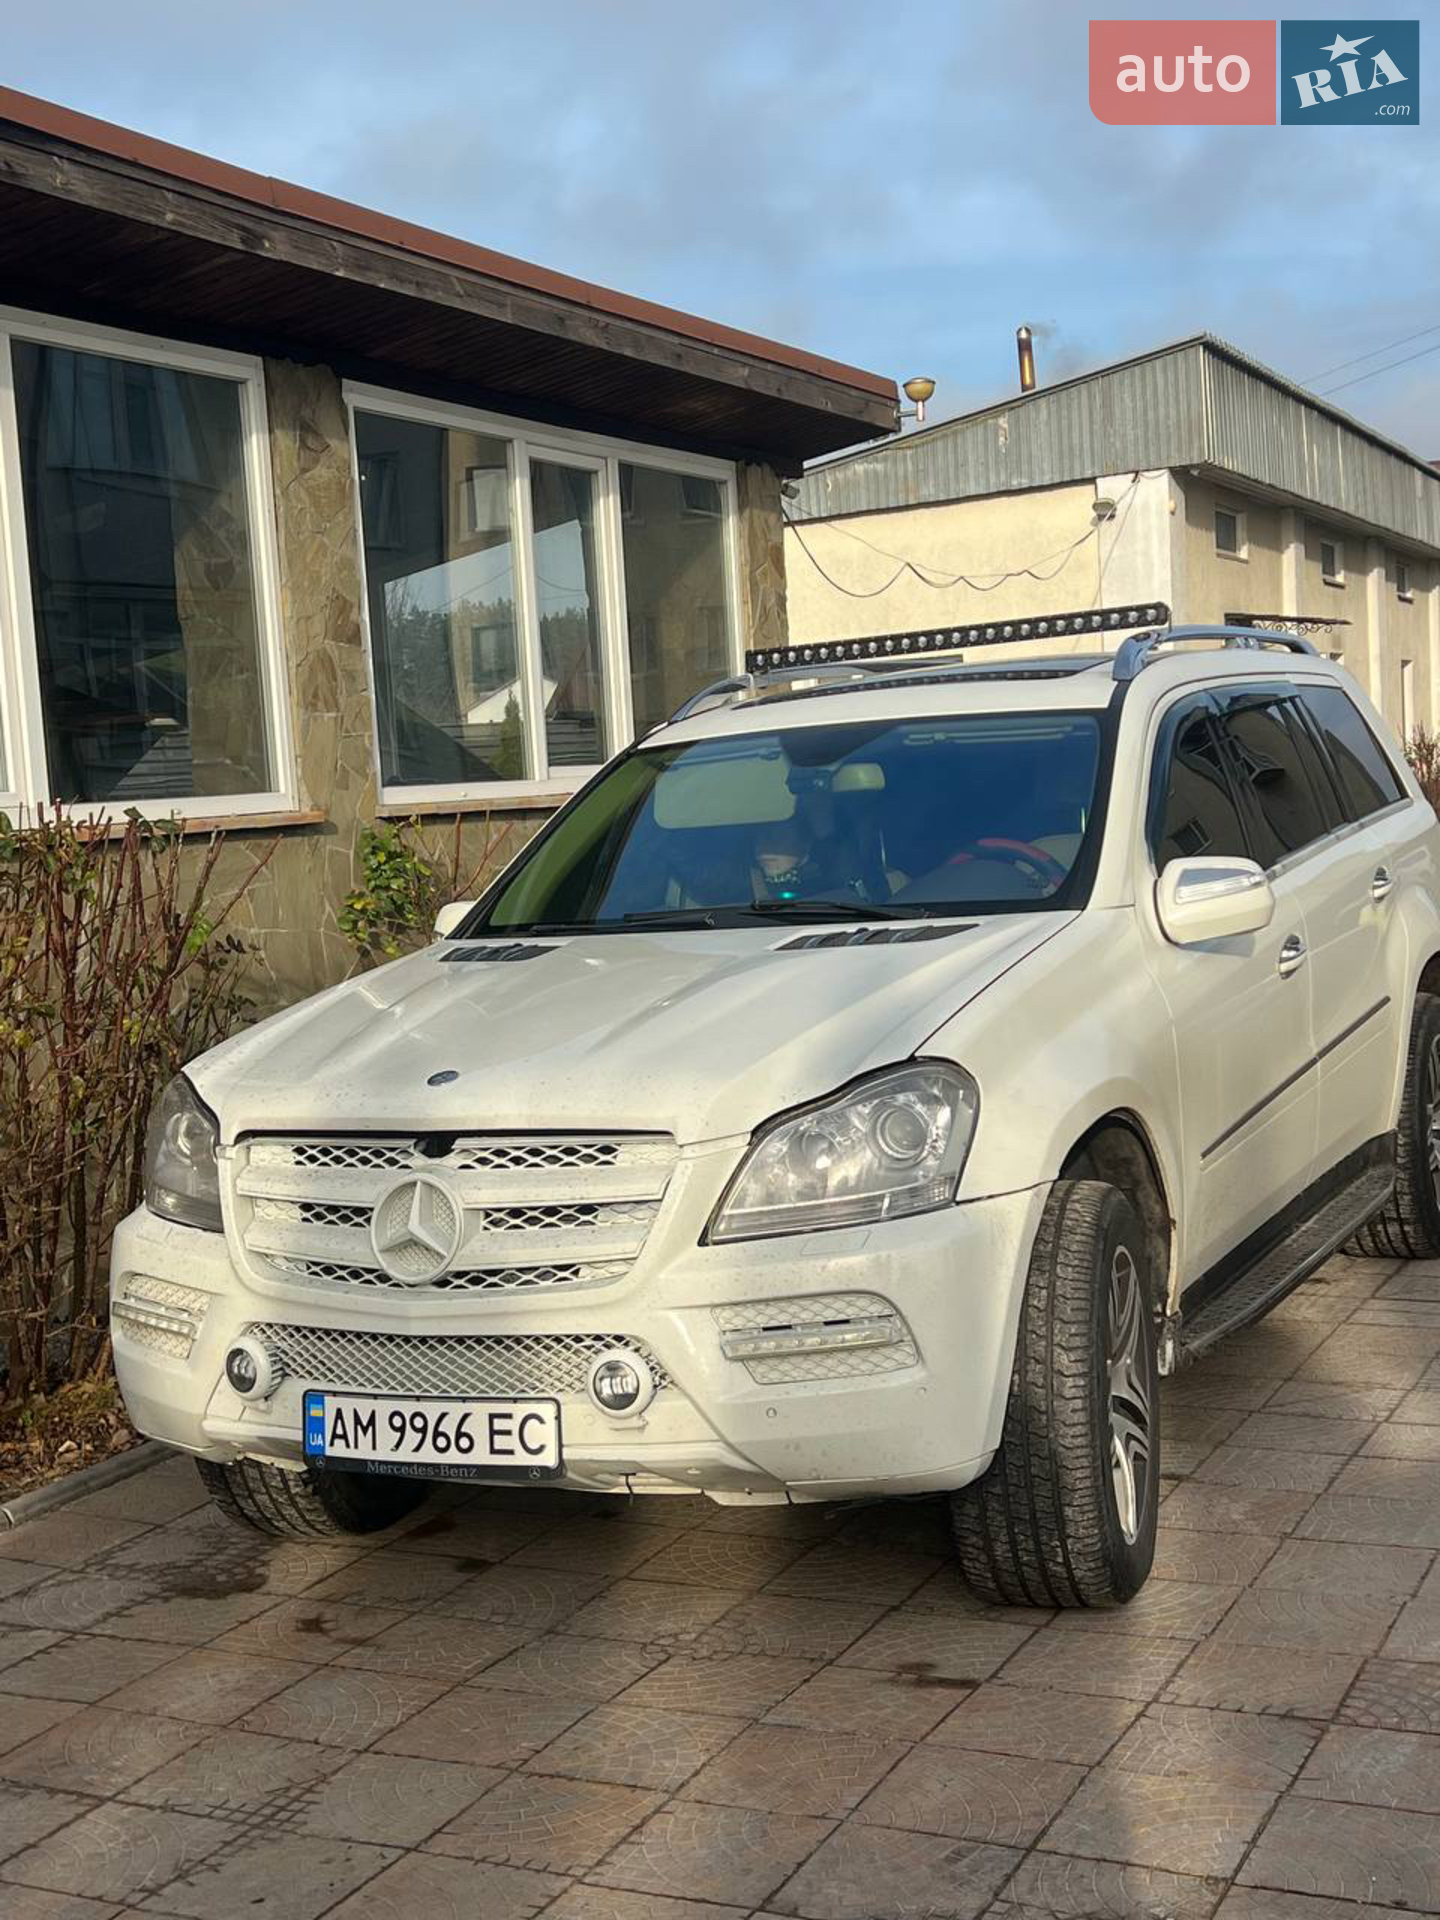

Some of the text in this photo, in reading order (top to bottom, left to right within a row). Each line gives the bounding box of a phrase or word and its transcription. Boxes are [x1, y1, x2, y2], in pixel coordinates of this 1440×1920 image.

[310, 1434, 324, 1447] UA
[330, 1408, 547, 1456] AM 9966 EC
[367, 1461, 478, 1478] Mercedes-Benz
